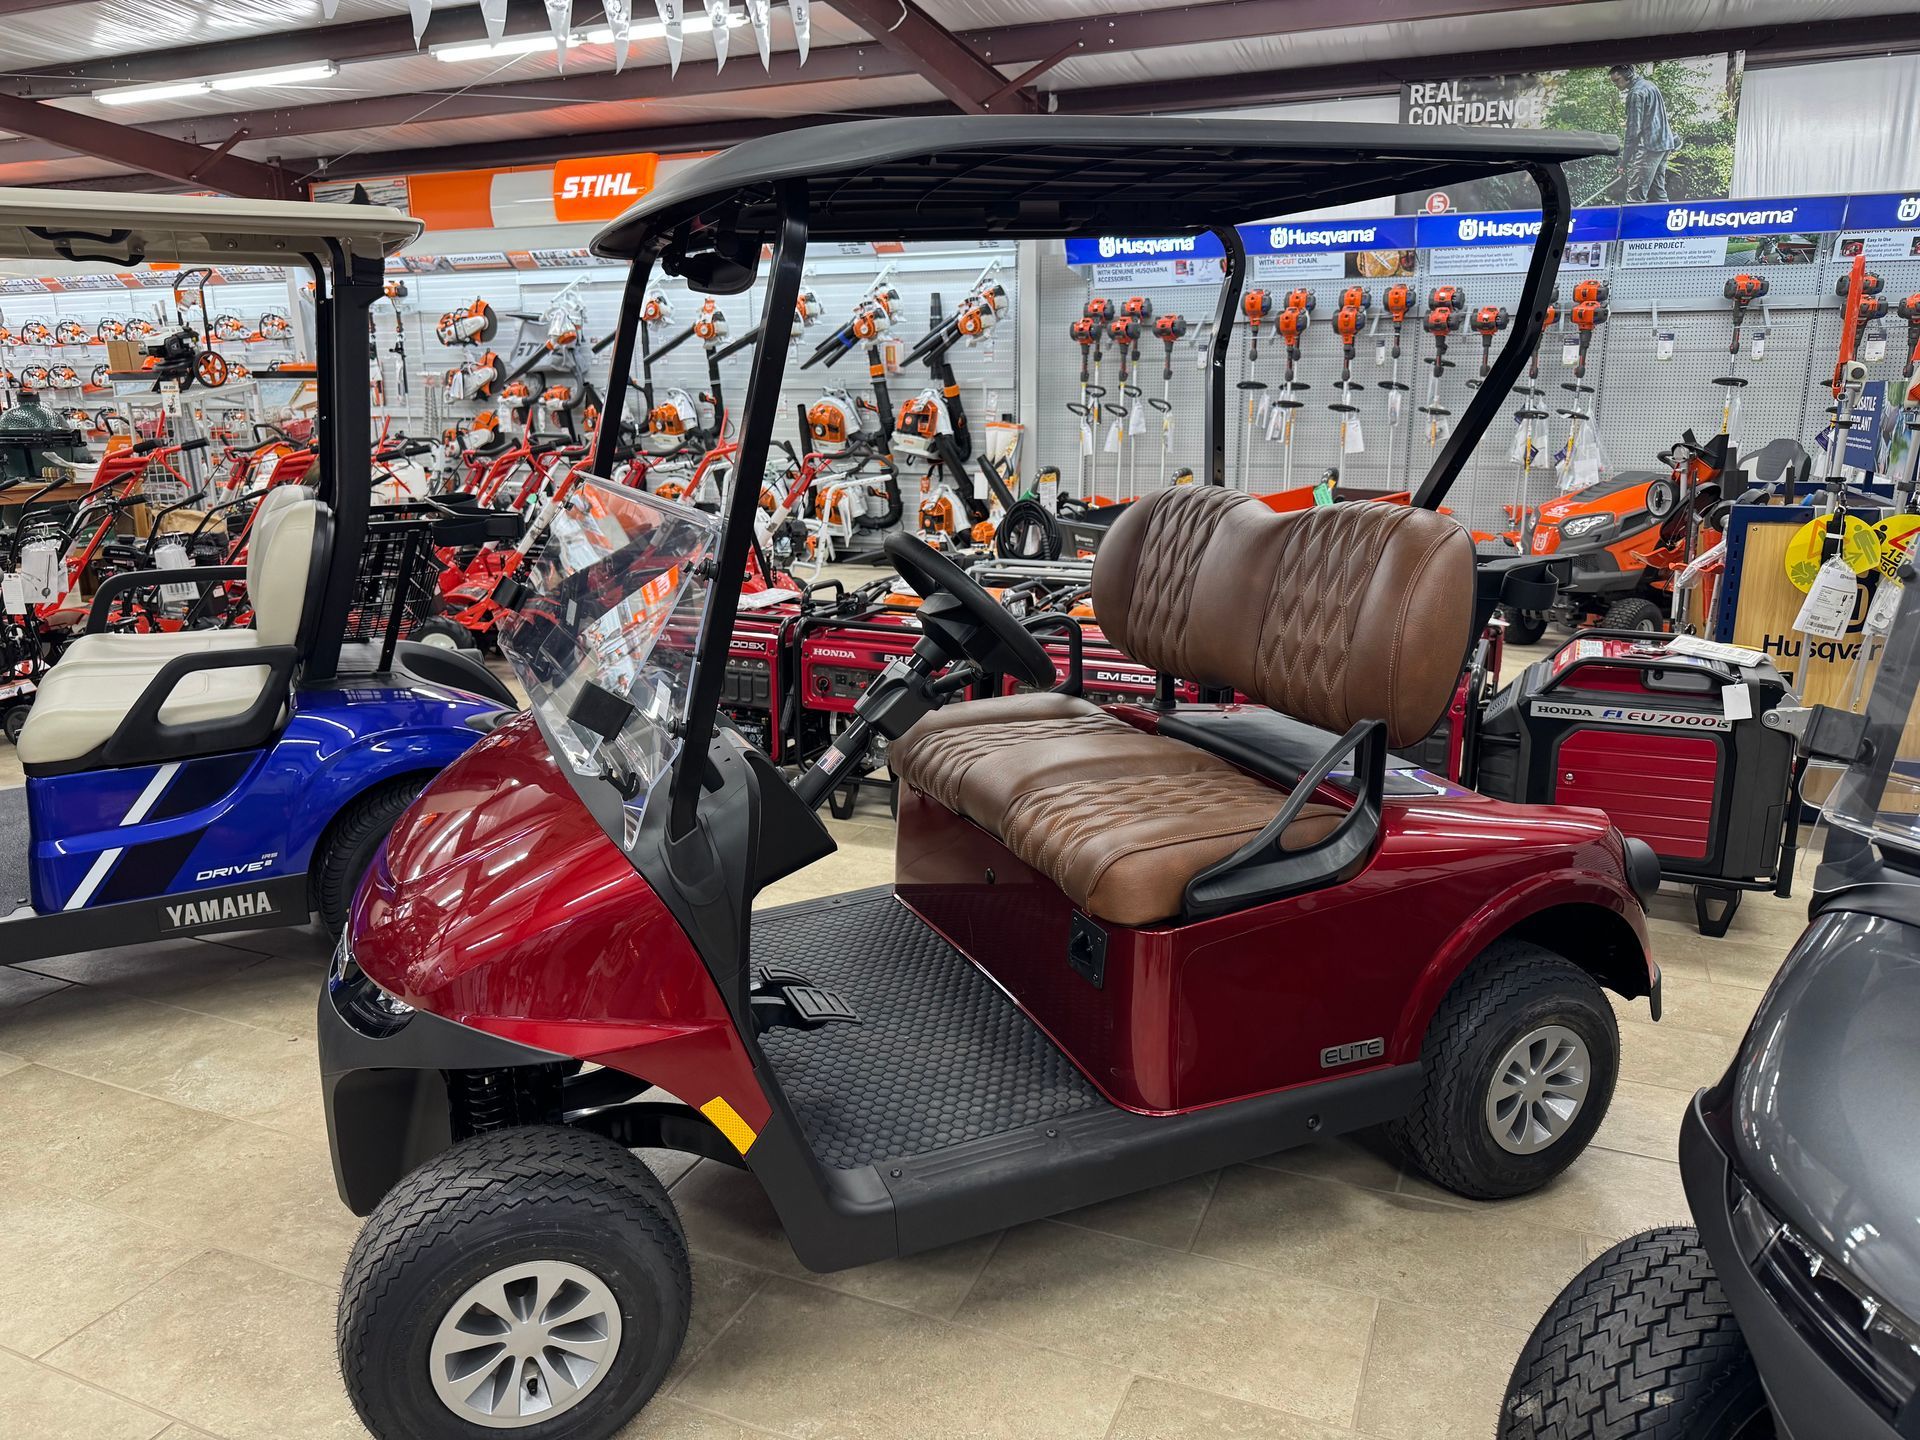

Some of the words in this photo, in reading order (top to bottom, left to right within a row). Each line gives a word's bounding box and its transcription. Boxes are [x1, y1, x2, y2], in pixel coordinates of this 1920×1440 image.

[1410, 81, 1464, 105] REAL
[1408, 96, 1542, 125] CONFIDENCE
[561, 172, 638, 199] STIHL
[1478, 218, 1574, 238] Husqva
[1688, 208, 1794, 228] Husqvarna
[1115, 236, 1195, 255] Husqvarna
[1288, 228, 1376, 246] Husqvarna
[812, 648, 856, 658] HONDA
[1537, 706, 1594, 717] HONDA
[166, 891, 272, 928] YAMAHA
